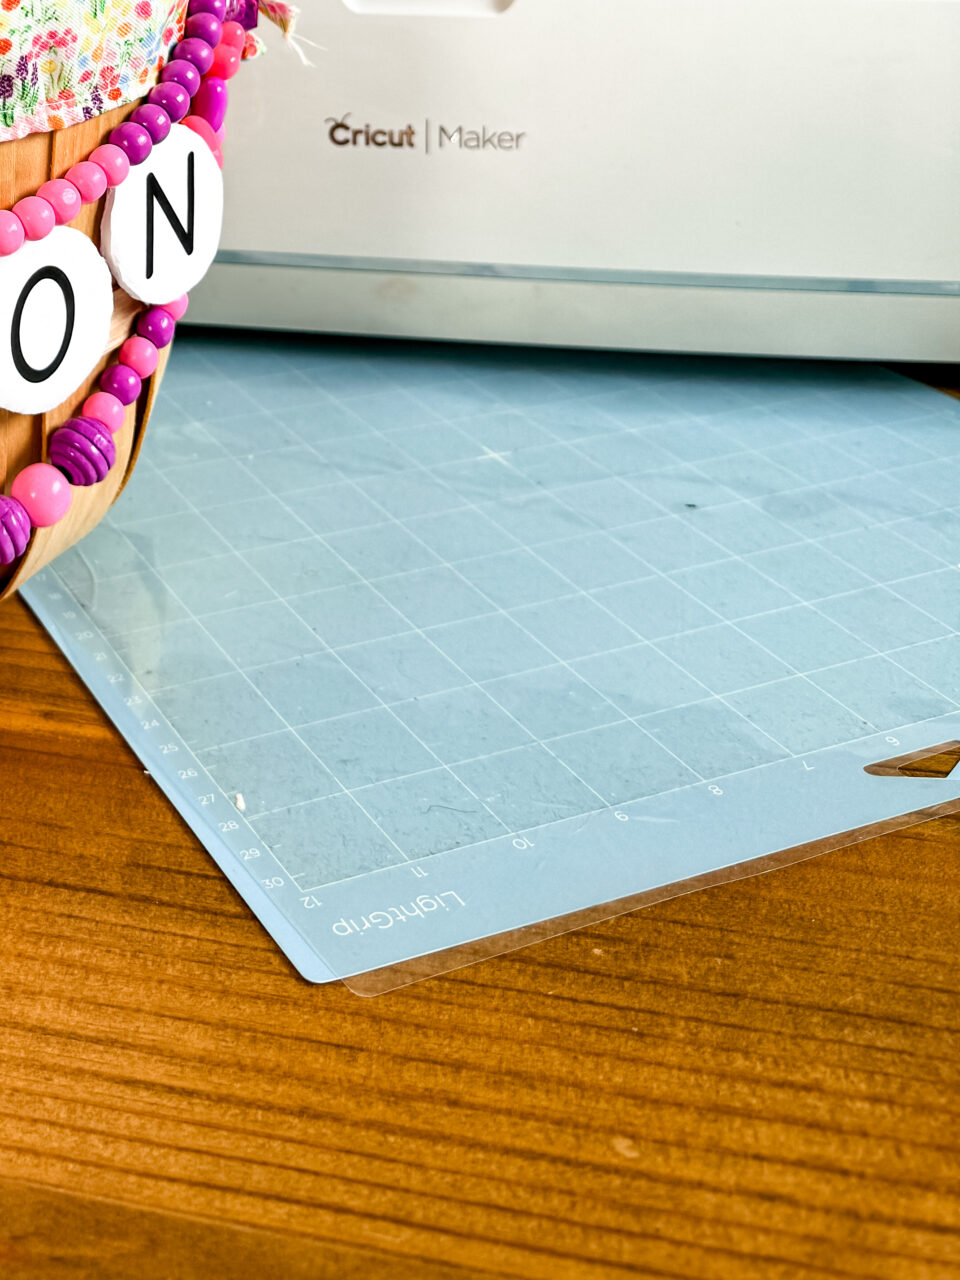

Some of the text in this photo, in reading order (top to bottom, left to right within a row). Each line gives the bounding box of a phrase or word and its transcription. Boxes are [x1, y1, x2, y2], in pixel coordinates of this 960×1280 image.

[327, 117, 526, 150] Cricut Maker
[141, 719, 160, 730] 24
[159, 743, 179, 754] 25
[178, 768, 198, 779] 26
[708, 784, 724, 797] 8
[198, 793, 215, 806] 27
[218, 820, 239, 833] 28
[512, 836, 536, 851] 10
[240, 847, 261, 861] 29
[261, 876, 285, 889] 30
[302, 894, 323, 910] 12
[331, 889, 467, 937] LightGrip
